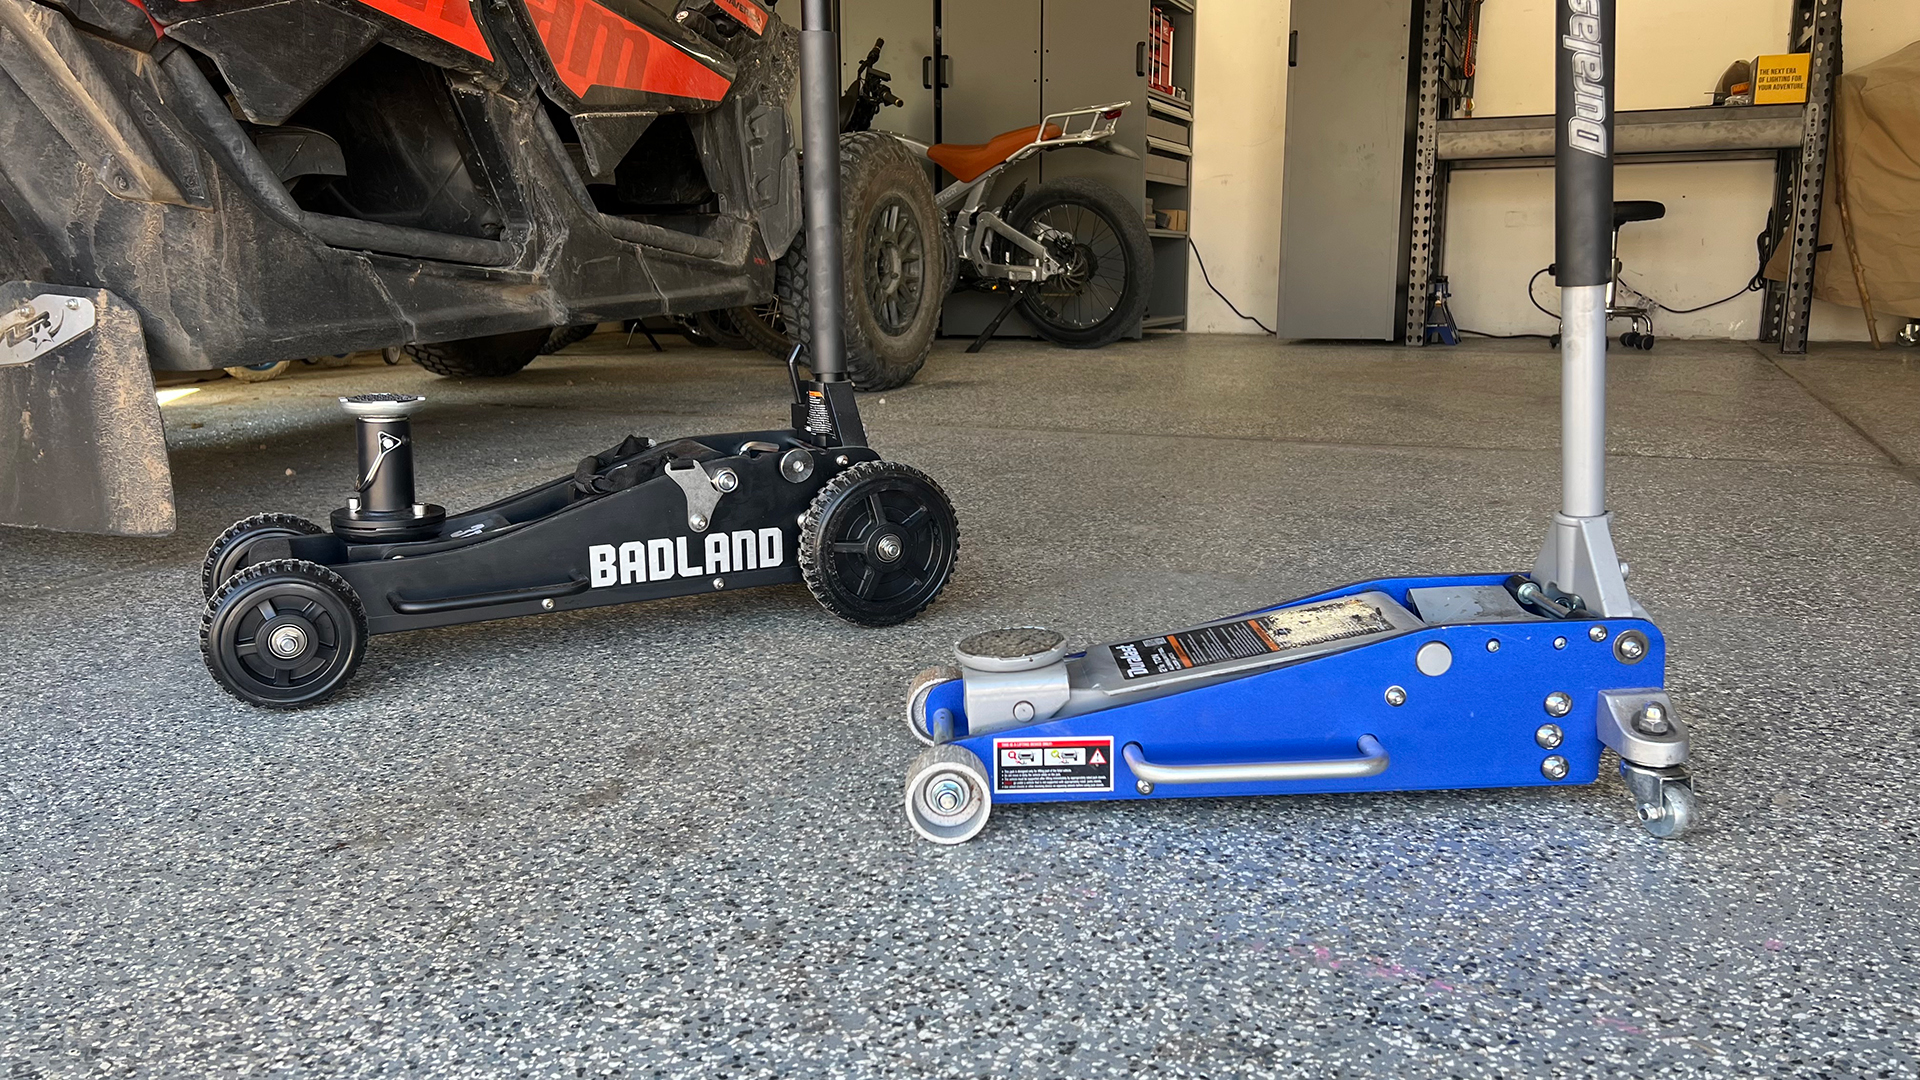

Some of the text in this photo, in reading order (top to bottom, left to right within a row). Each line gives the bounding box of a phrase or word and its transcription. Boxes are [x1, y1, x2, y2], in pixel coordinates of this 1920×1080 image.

[1766, 75, 1791, 83] LIGHTING
[588, 526, 784, 589] BADLAND
[1115, 643, 1149, 678] Duralast
